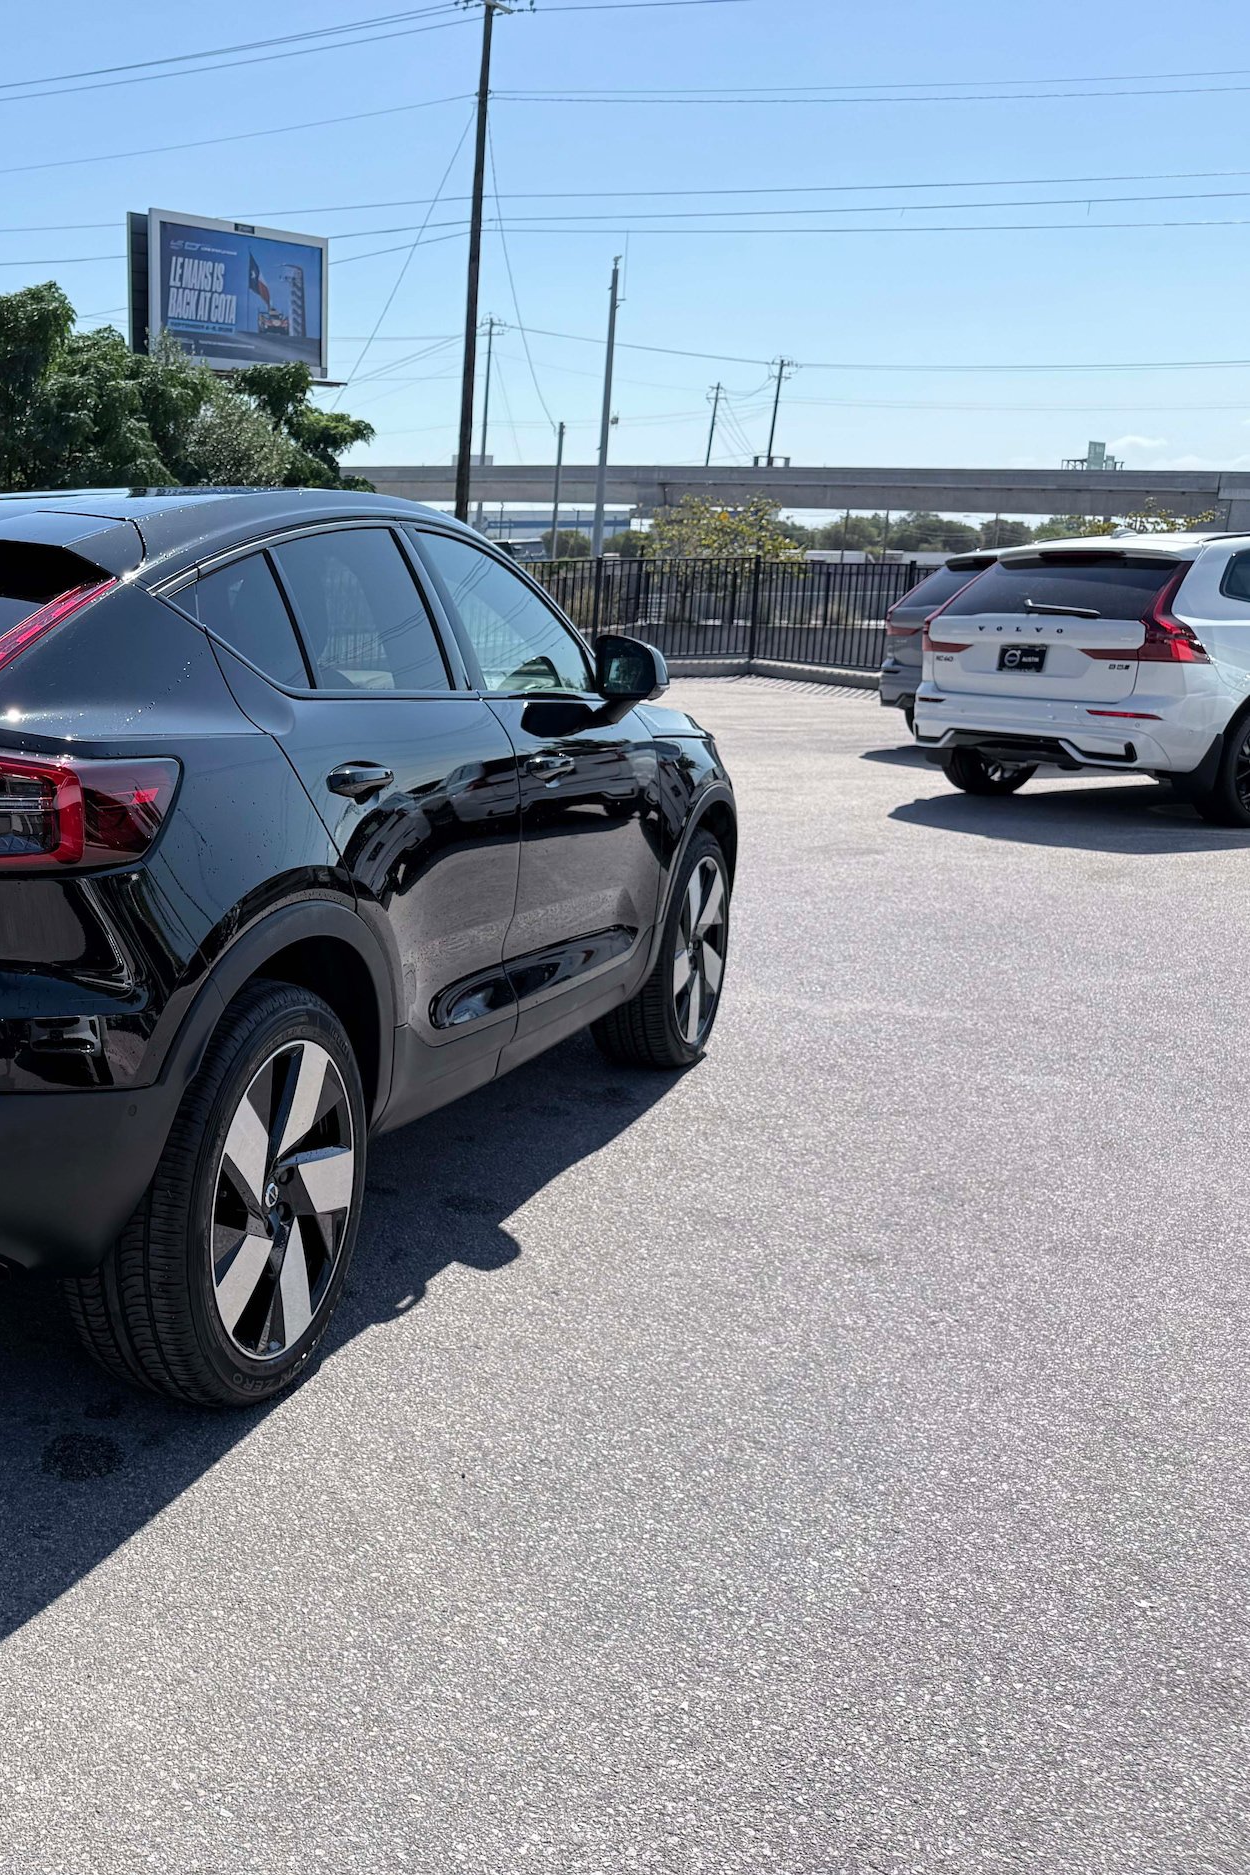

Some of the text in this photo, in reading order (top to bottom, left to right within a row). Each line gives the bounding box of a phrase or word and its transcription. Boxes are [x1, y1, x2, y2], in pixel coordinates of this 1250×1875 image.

[169, 256, 225, 292] LE MANS IS
[168, 287, 237, 324] BACK AT COTA
[978, 625, 1063, 633] VOLVO
